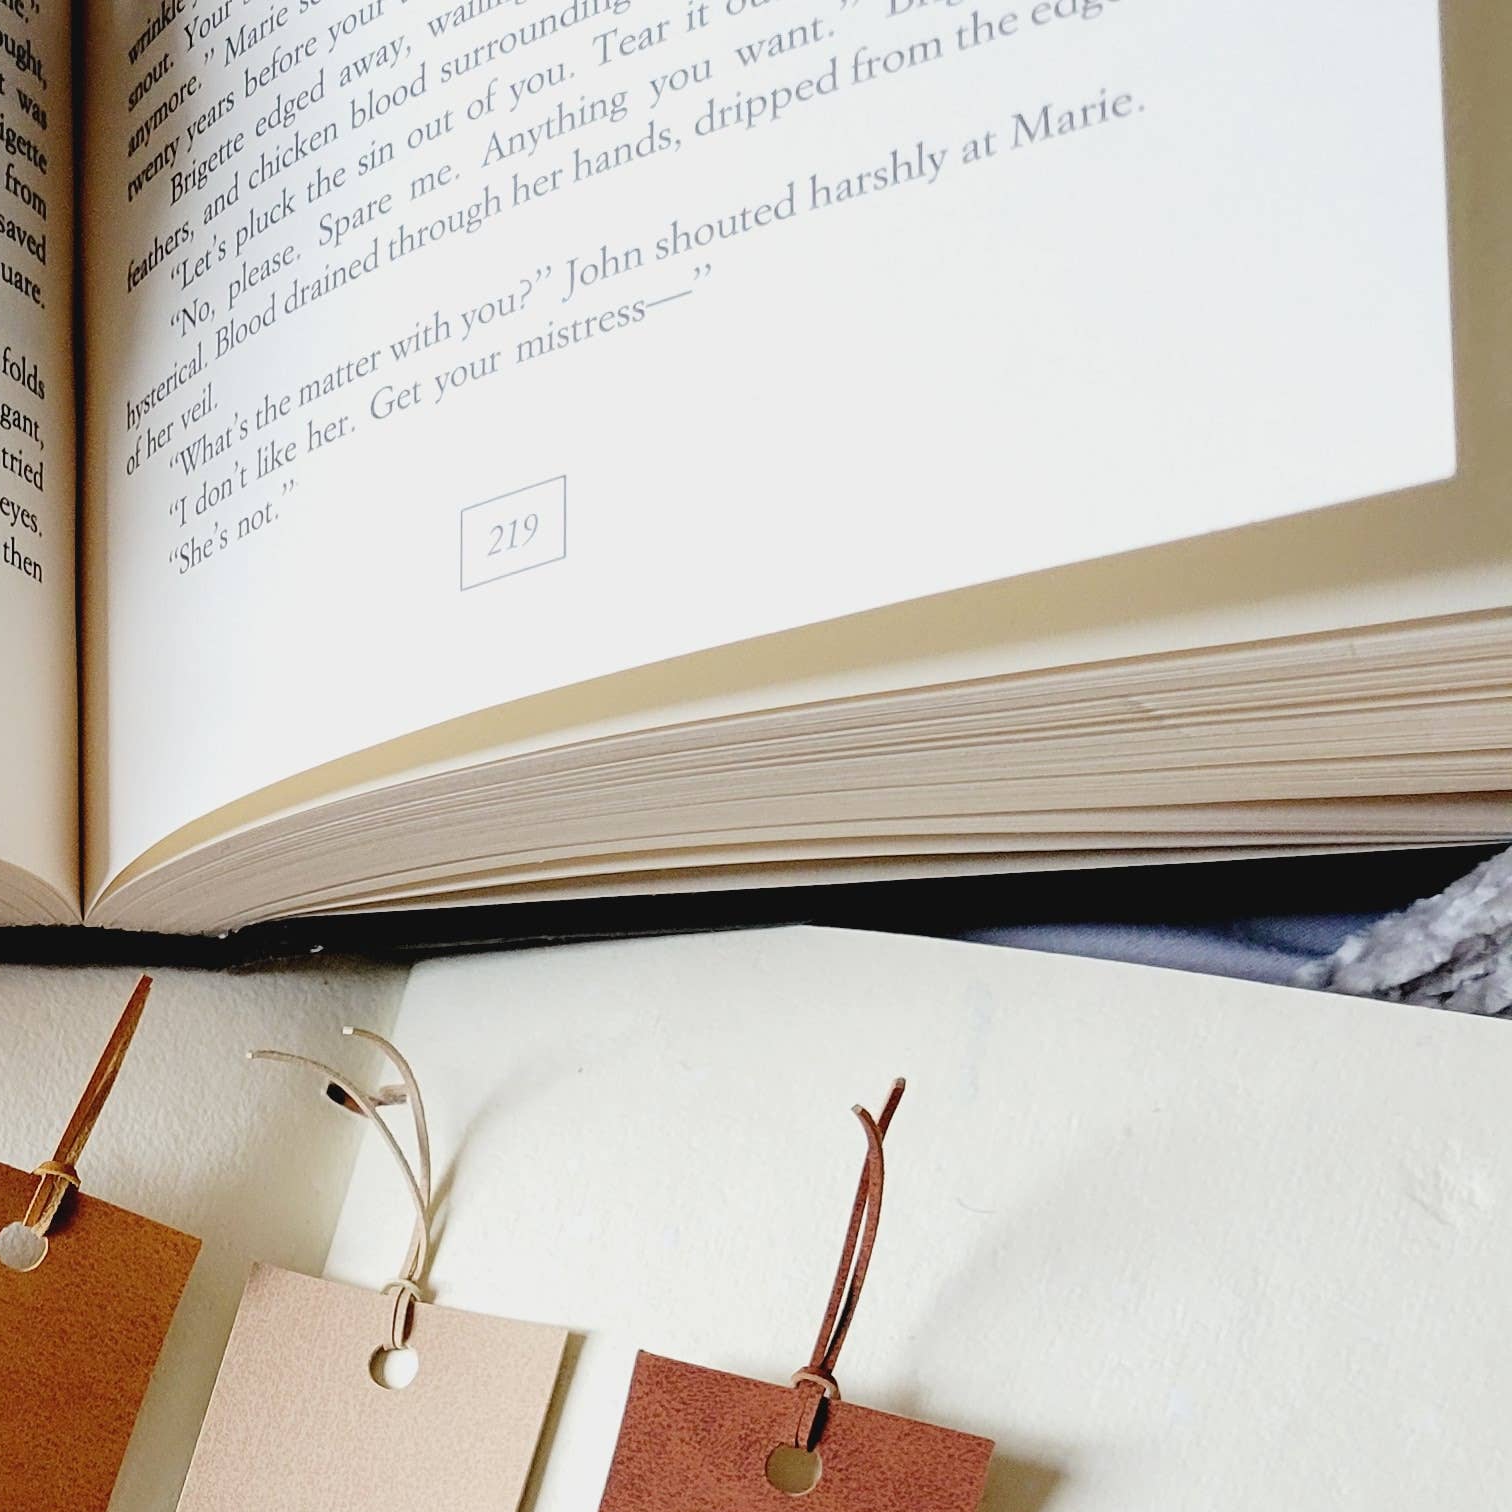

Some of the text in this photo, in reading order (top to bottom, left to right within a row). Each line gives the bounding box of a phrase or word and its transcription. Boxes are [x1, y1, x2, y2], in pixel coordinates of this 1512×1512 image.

[184, 0, 232, 51] Your
[225, 8, 287, 66] Marie
[16, 88, 47, 130] was
[187, 92, 234, 152] years
[245, 37, 316, 97] before
[329, 0, 382, 52] your
[204, 172, 238, 225] and
[249, 123, 337, 189] chicken
[351, 62, 426, 129] blood
[441, 0, 631, 83] surrounding
[171, 37, 410, 206] Brigette edged away,
[237, 188, 294, 256] pluck
[308, 168, 345, 203] the
[359, 141, 393, 176] sin
[408, 111, 452, 148] out
[467, 78, 498, 120] of
[510, 63, 574, 112] you.
[593, 21, 670, 65] Tear
[687, 0, 708, 31] it
[5, 163, 46, 220] from
[126, 10, 1018, 430] hysterical. Blood drained through her hands, dripped from the
[229, 246, 301, 309] please.
[320, 195, 391, 246] Spare
[410, 165, 459, 199] me.
[483, 92, 628, 166] Anything
[650, 60, 712, 108] you
[257, 395, 290, 430] the
[300, 351, 380, 405] matter
[390, 312, 450, 360] with
[562, 245, 642, 302] John
[656, 181, 796, 260] shouted
[810, 141, 947, 210] harshly
[962, 132, 996, 164] at
[1012, 88, 1144, 148] Marie.
[2, 347, 44, 399] folds
[126, 383, 218, 475] of her veil.
[258, 441, 296, 478] like
[308, 419, 355, 451] her.
[371, 384, 420, 419] Get
[435, 352, 501, 403] your
[2, 448, 43, 491] tried
[0, 499, 42, 538] eyes.
[488, 514, 538, 555] 219
[3, 537, 42, 582] then
